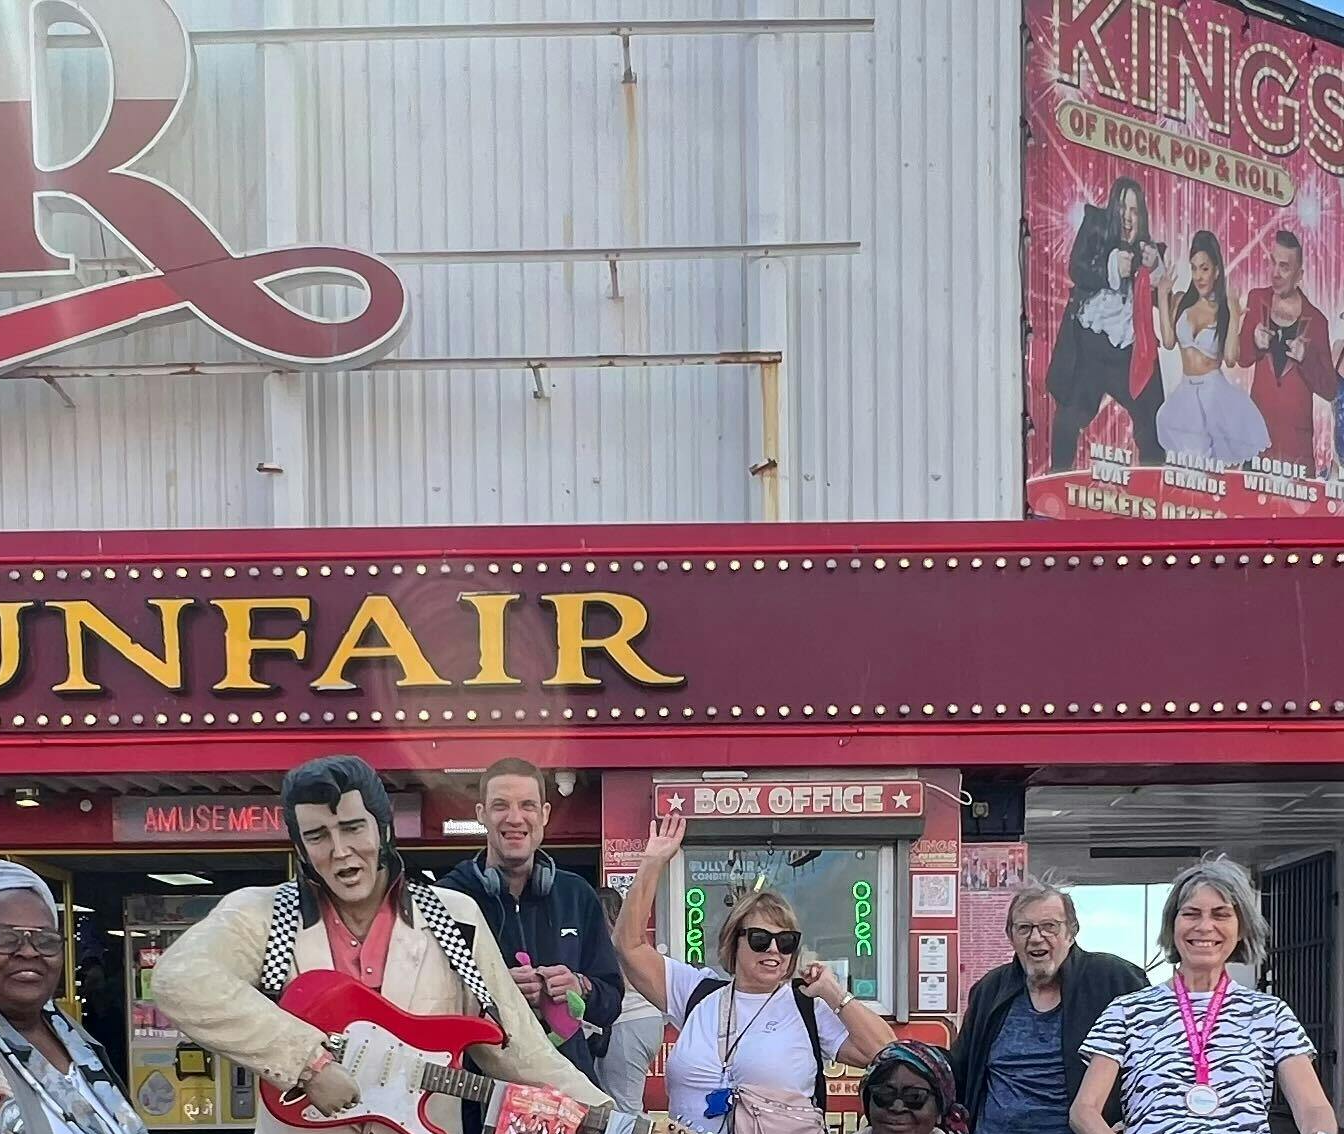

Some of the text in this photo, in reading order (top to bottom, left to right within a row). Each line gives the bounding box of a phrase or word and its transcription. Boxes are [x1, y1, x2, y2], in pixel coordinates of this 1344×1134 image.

[1069, 108, 1096, 140] OF
[1170, 139, 1211, 174] POP
[1215, 155, 1230, 182] &
[1235, 160, 1284, 199] ROLL
[1090, 443, 1133, 465] MEAT
[1251, 456, 1307, 480] ROBBIE
[1164, 470, 1227, 496] GRANDE
[1244, 474, 1318, 502] WILLIAMS
[1065, 482, 1157, 520] TICKETS
[694, 785, 884, 815] BOX OFFICE
[144, 804, 285, 833] AMUSEMEN
